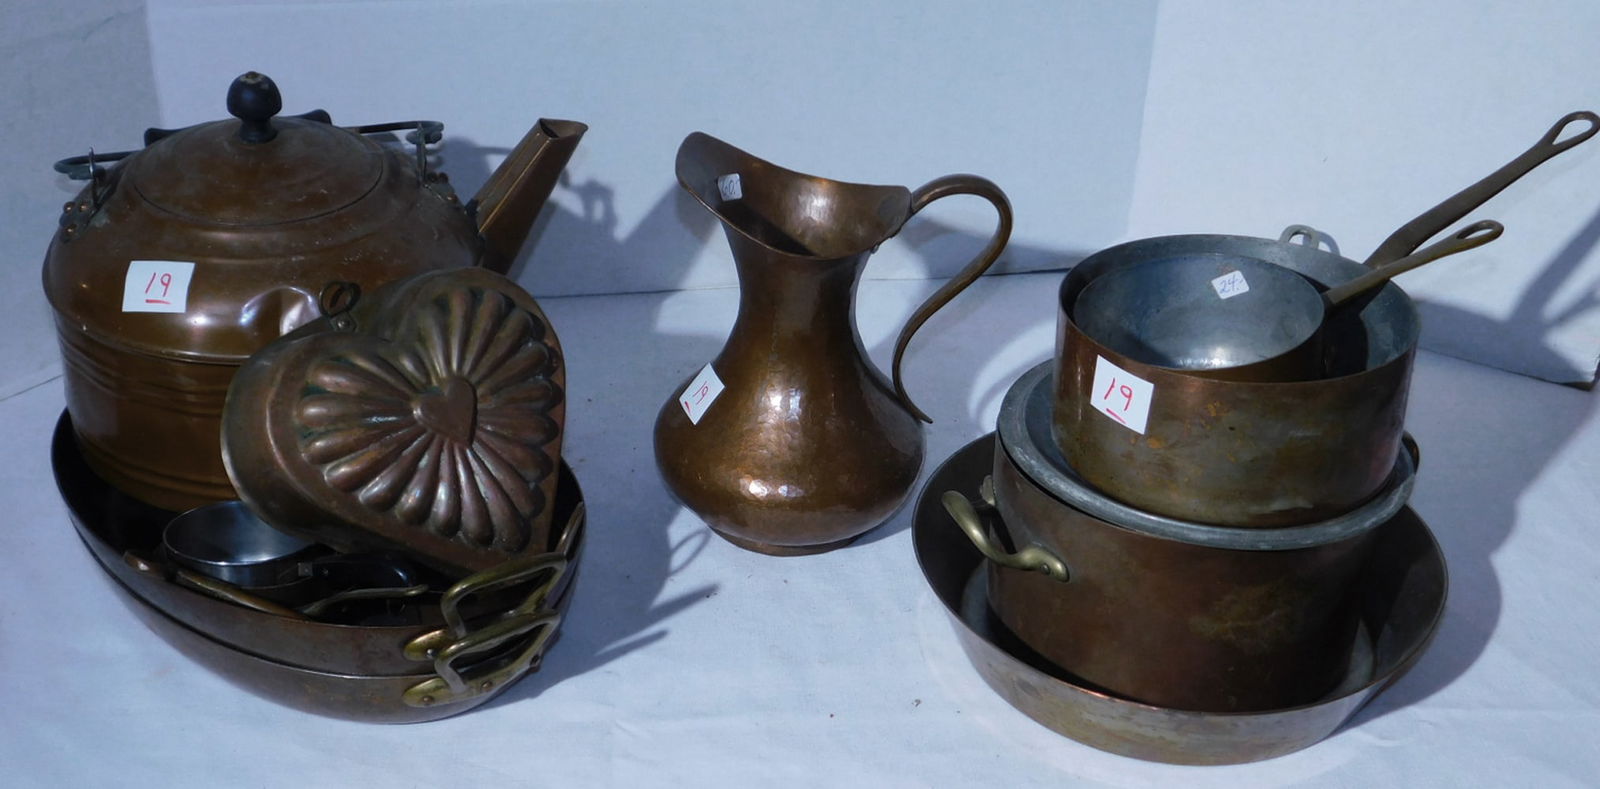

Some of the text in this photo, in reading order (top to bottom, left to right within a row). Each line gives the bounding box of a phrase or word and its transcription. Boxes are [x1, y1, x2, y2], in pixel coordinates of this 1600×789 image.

[144, 271, 172, 298] 19
[692, 380, 709, 406] 19
[1103, 377, 1133, 412] 19
